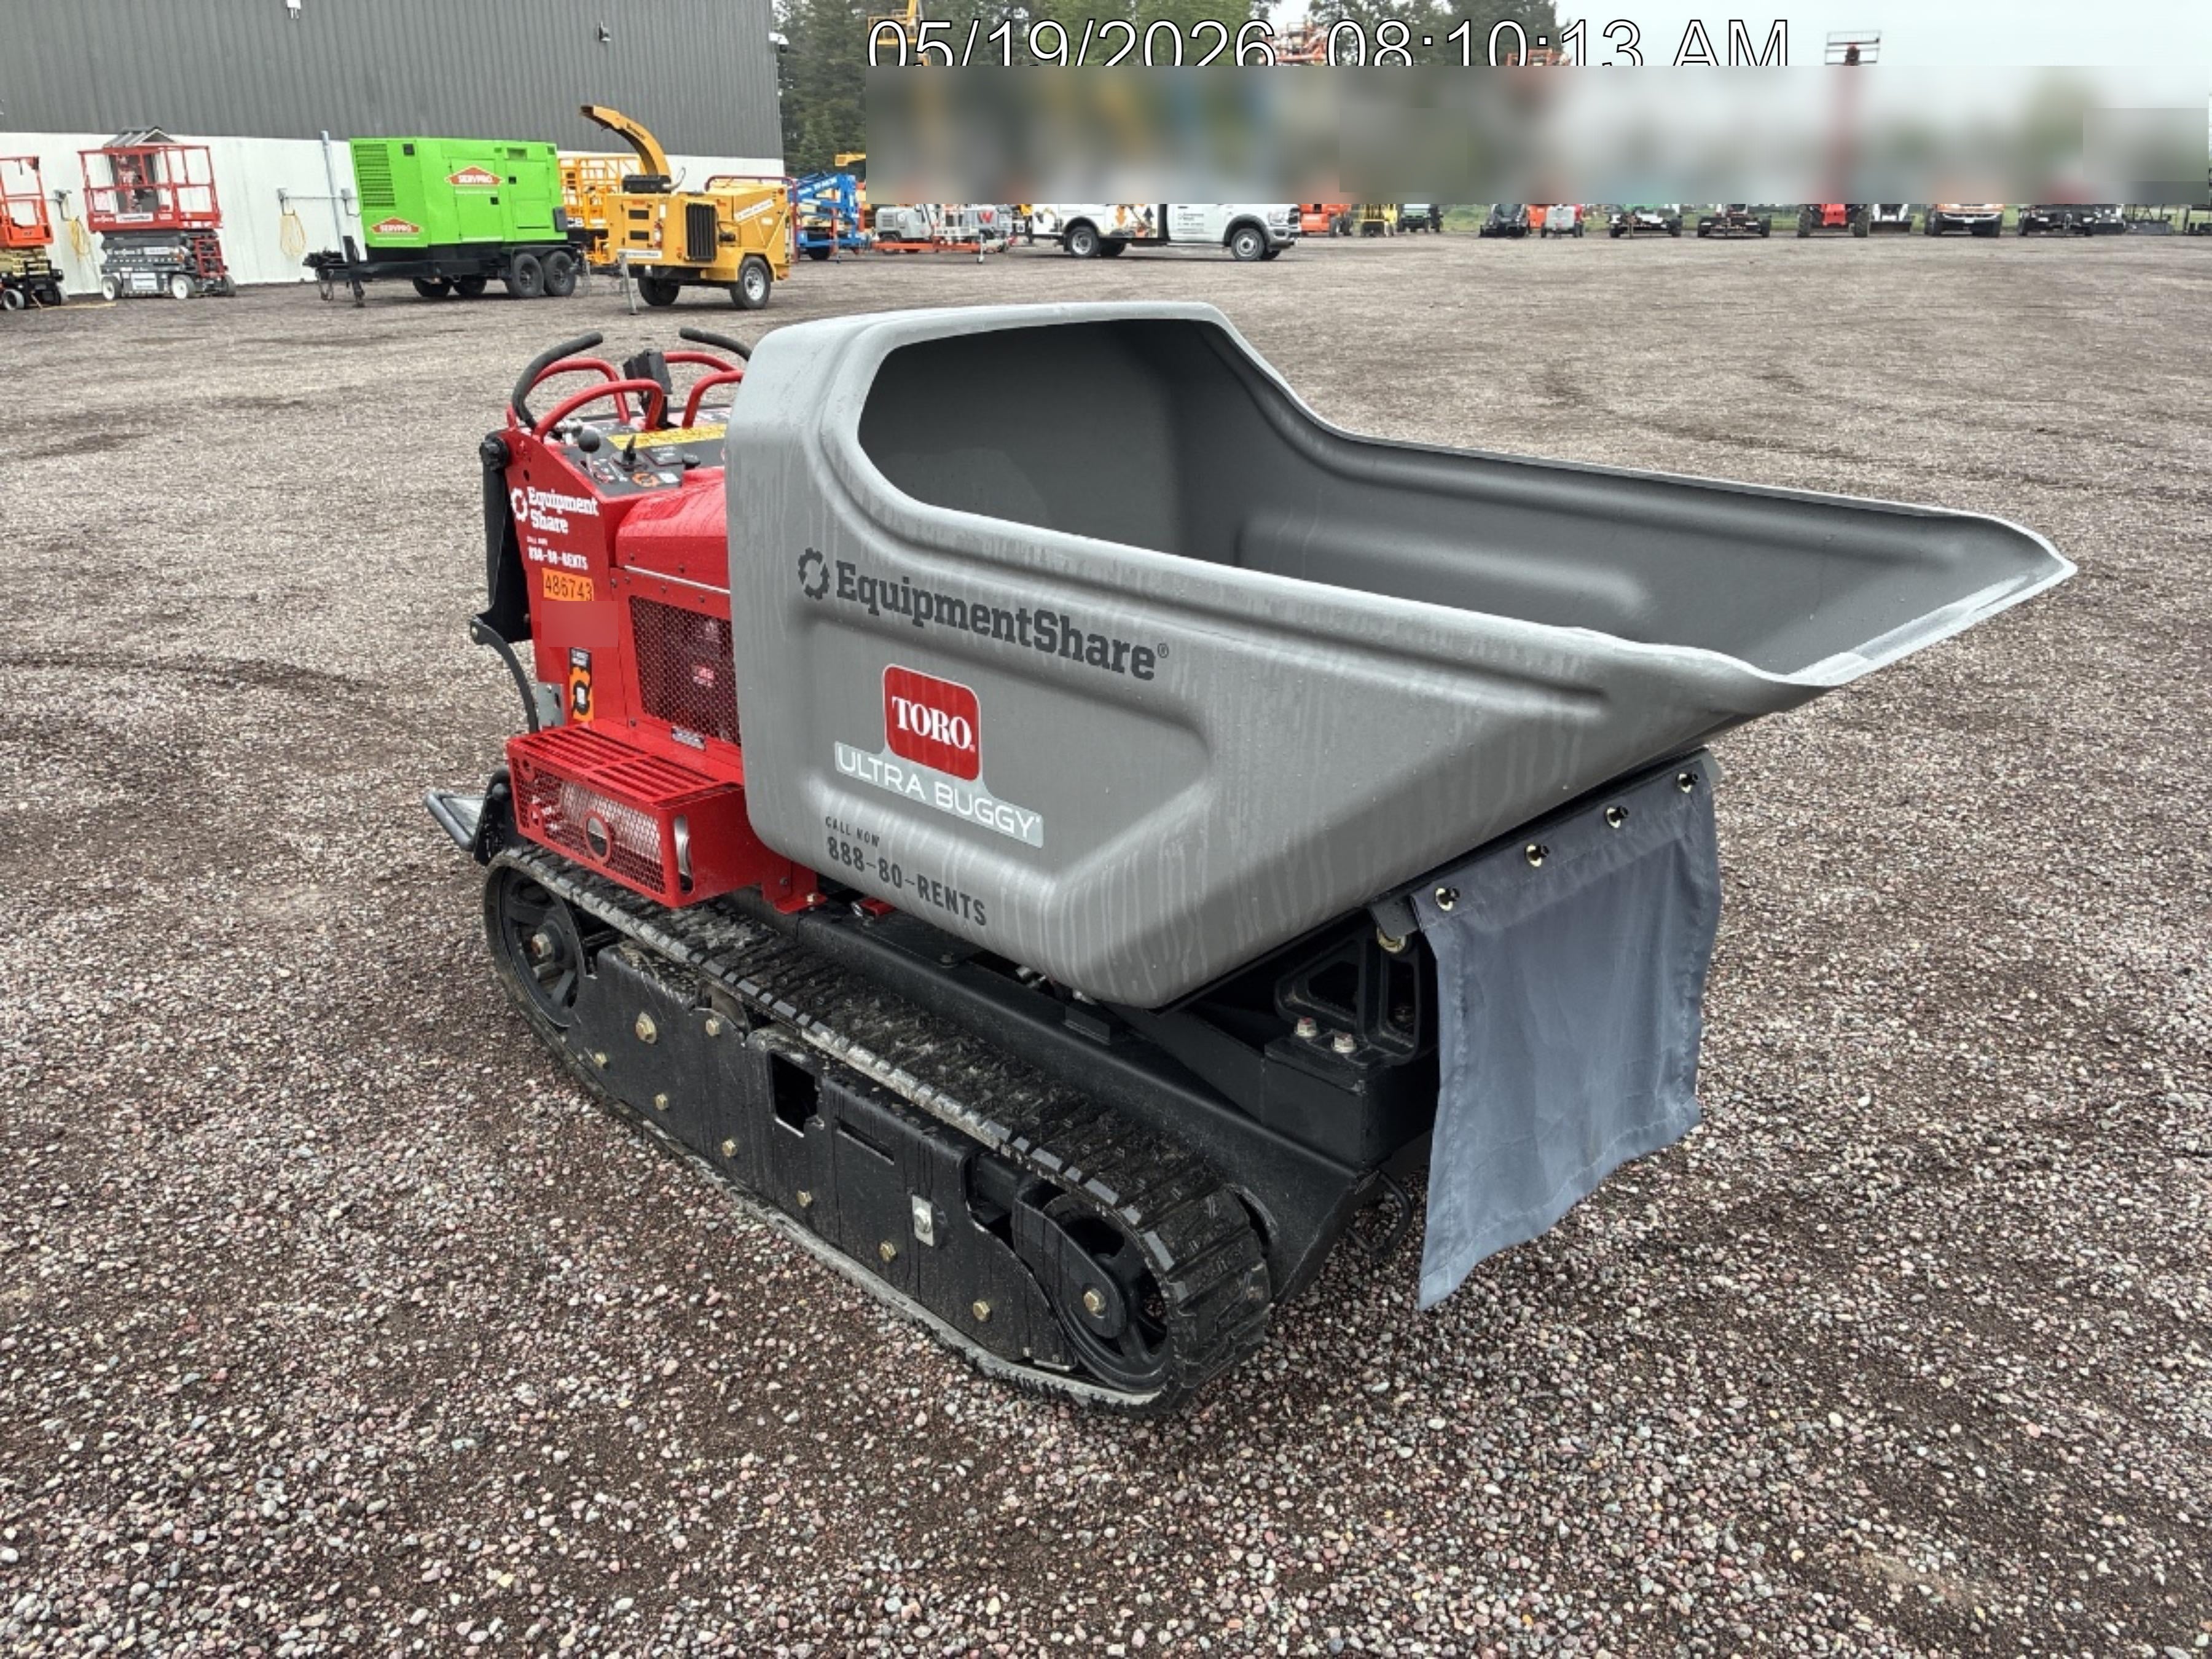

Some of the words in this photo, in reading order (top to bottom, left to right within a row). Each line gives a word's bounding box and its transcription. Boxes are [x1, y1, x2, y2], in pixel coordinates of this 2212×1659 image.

[527, 486, 600, 517] Equipment
[530, 508, 569, 535] Share
[545, 574, 592, 601] 486743
[838, 745, 926, 801] ULTRA
[825, 816, 851, 836] CALL
[856, 827, 880, 847] NOW
[827, 836, 987, 926] 888-80-RENTS
